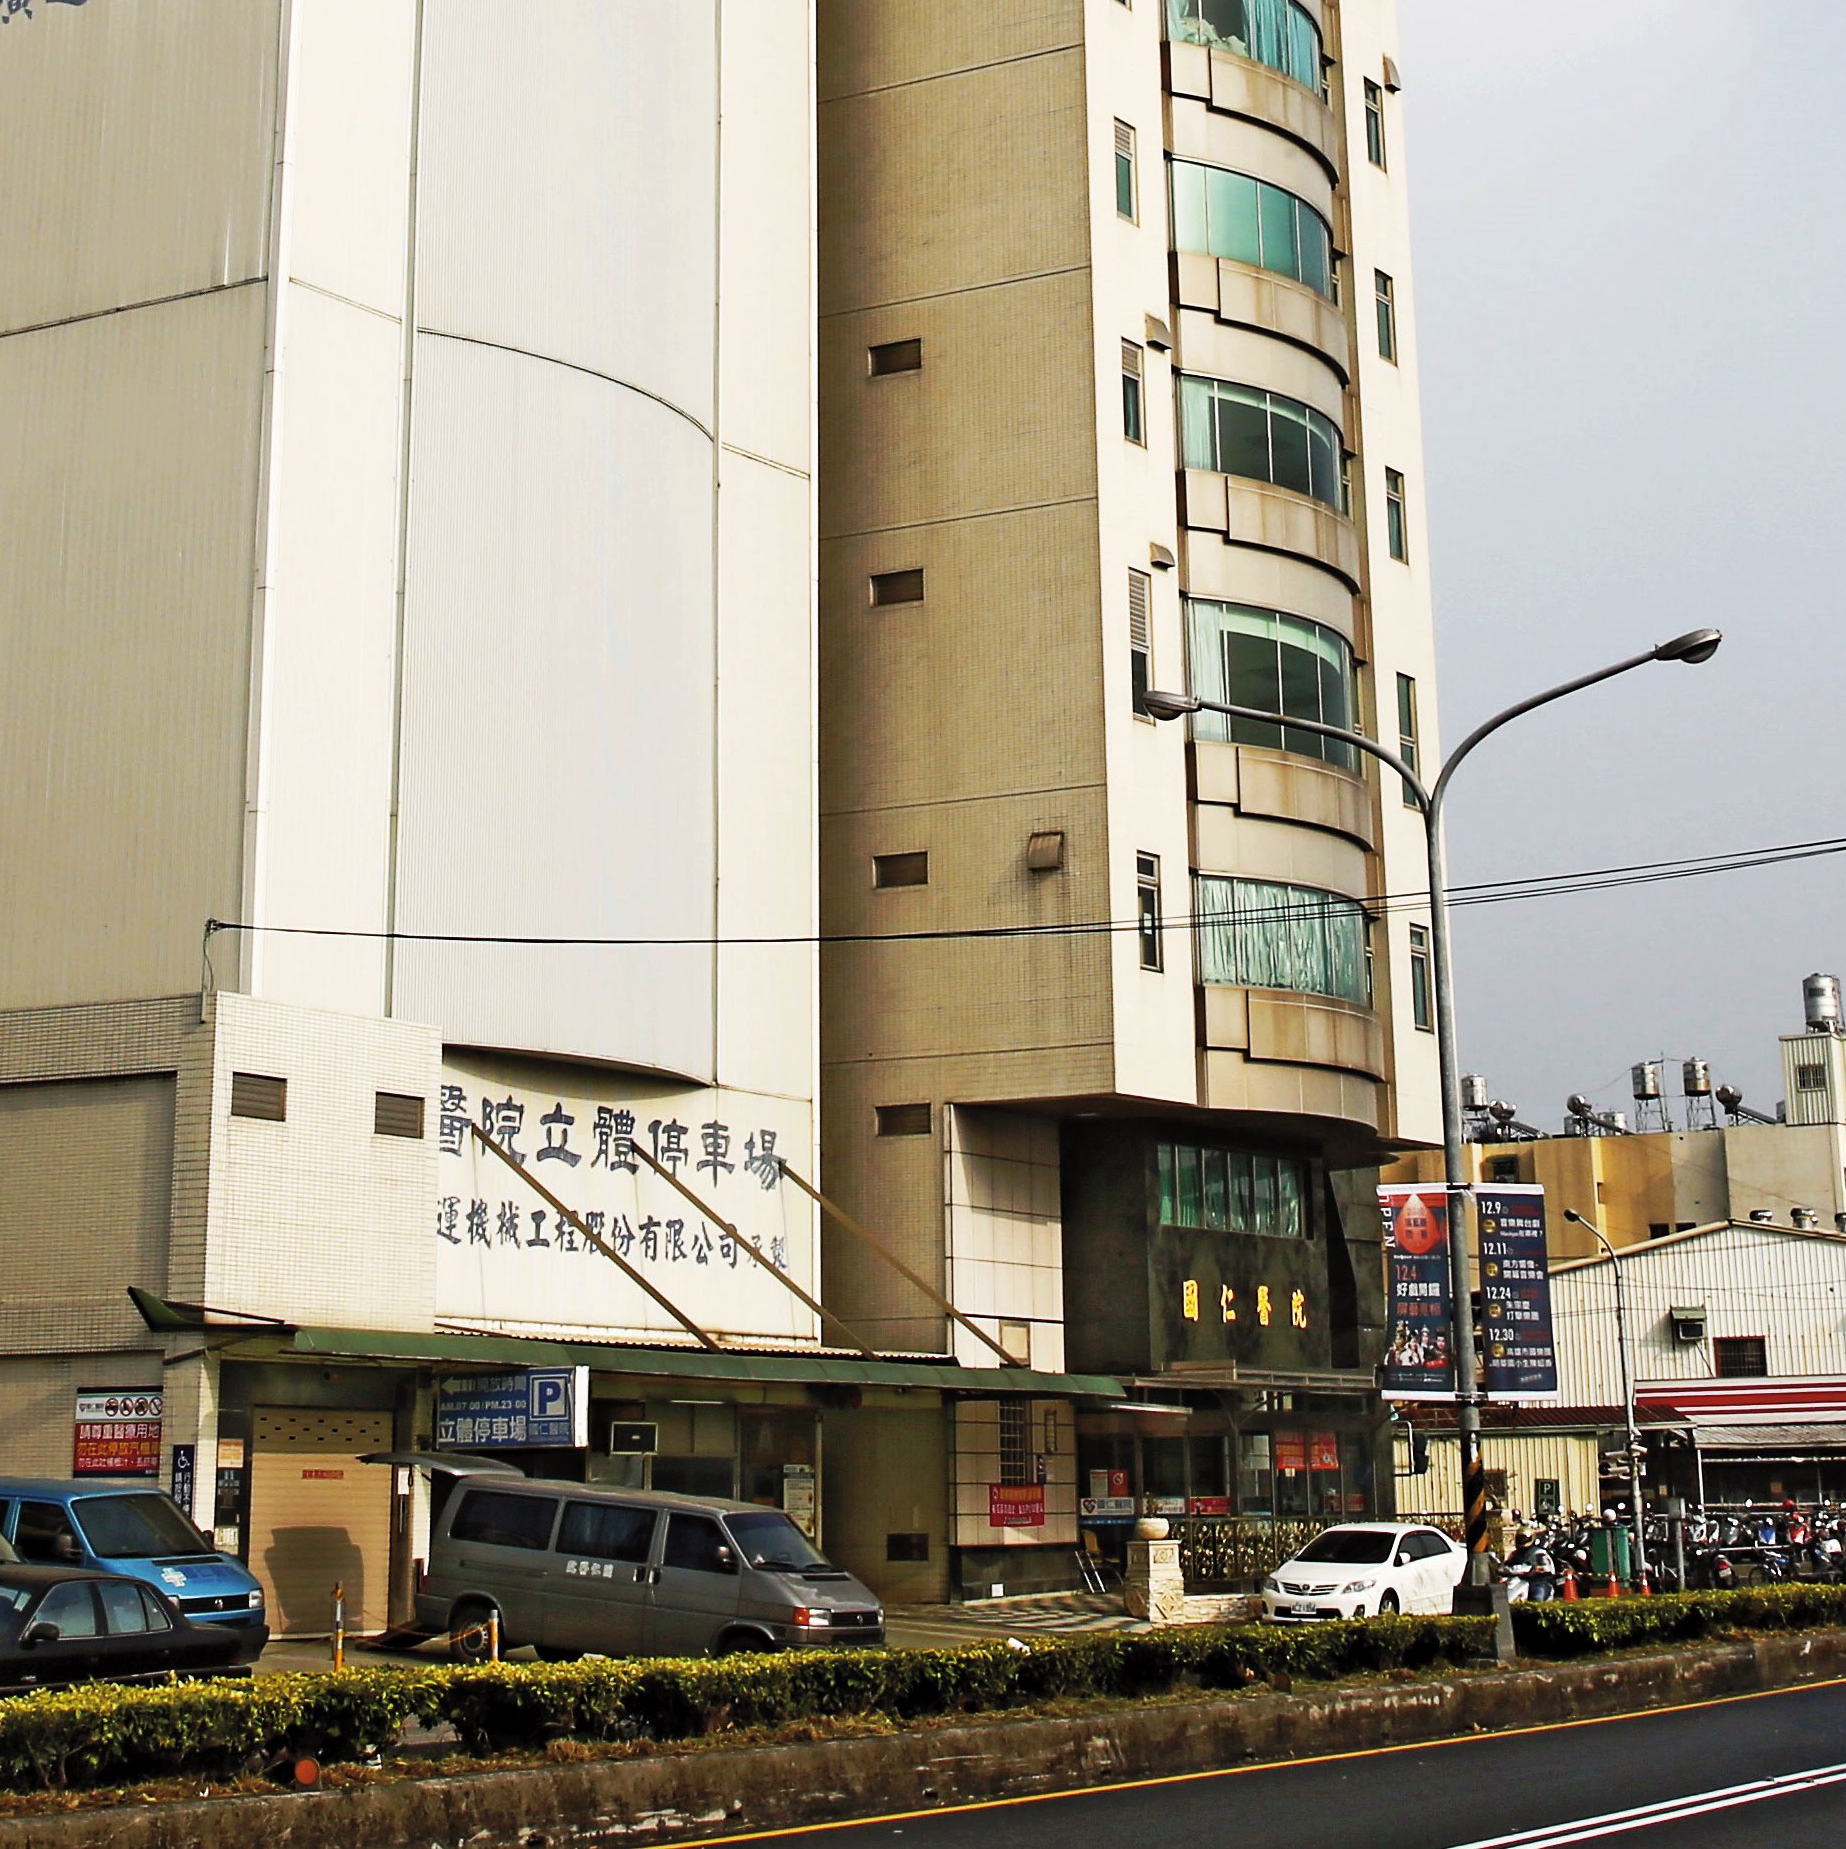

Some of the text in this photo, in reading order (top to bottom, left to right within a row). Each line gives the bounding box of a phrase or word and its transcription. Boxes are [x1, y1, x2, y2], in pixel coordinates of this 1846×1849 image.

[1481, 1201, 1501, 1215] 12.9
[1483, 1242, 1507, 1255] 12.11
[1486, 1286, 1511, 1300] 12.24
[1183, 1279, 1307, 1329] 國仁醫院
[1489, 1328, 1514, 1341] 12.30
[539, 1381, 561, 1414] P
[439, 1416, 527, 1443] 立體停車場
[1543, 1483, 1551, 1493] P
